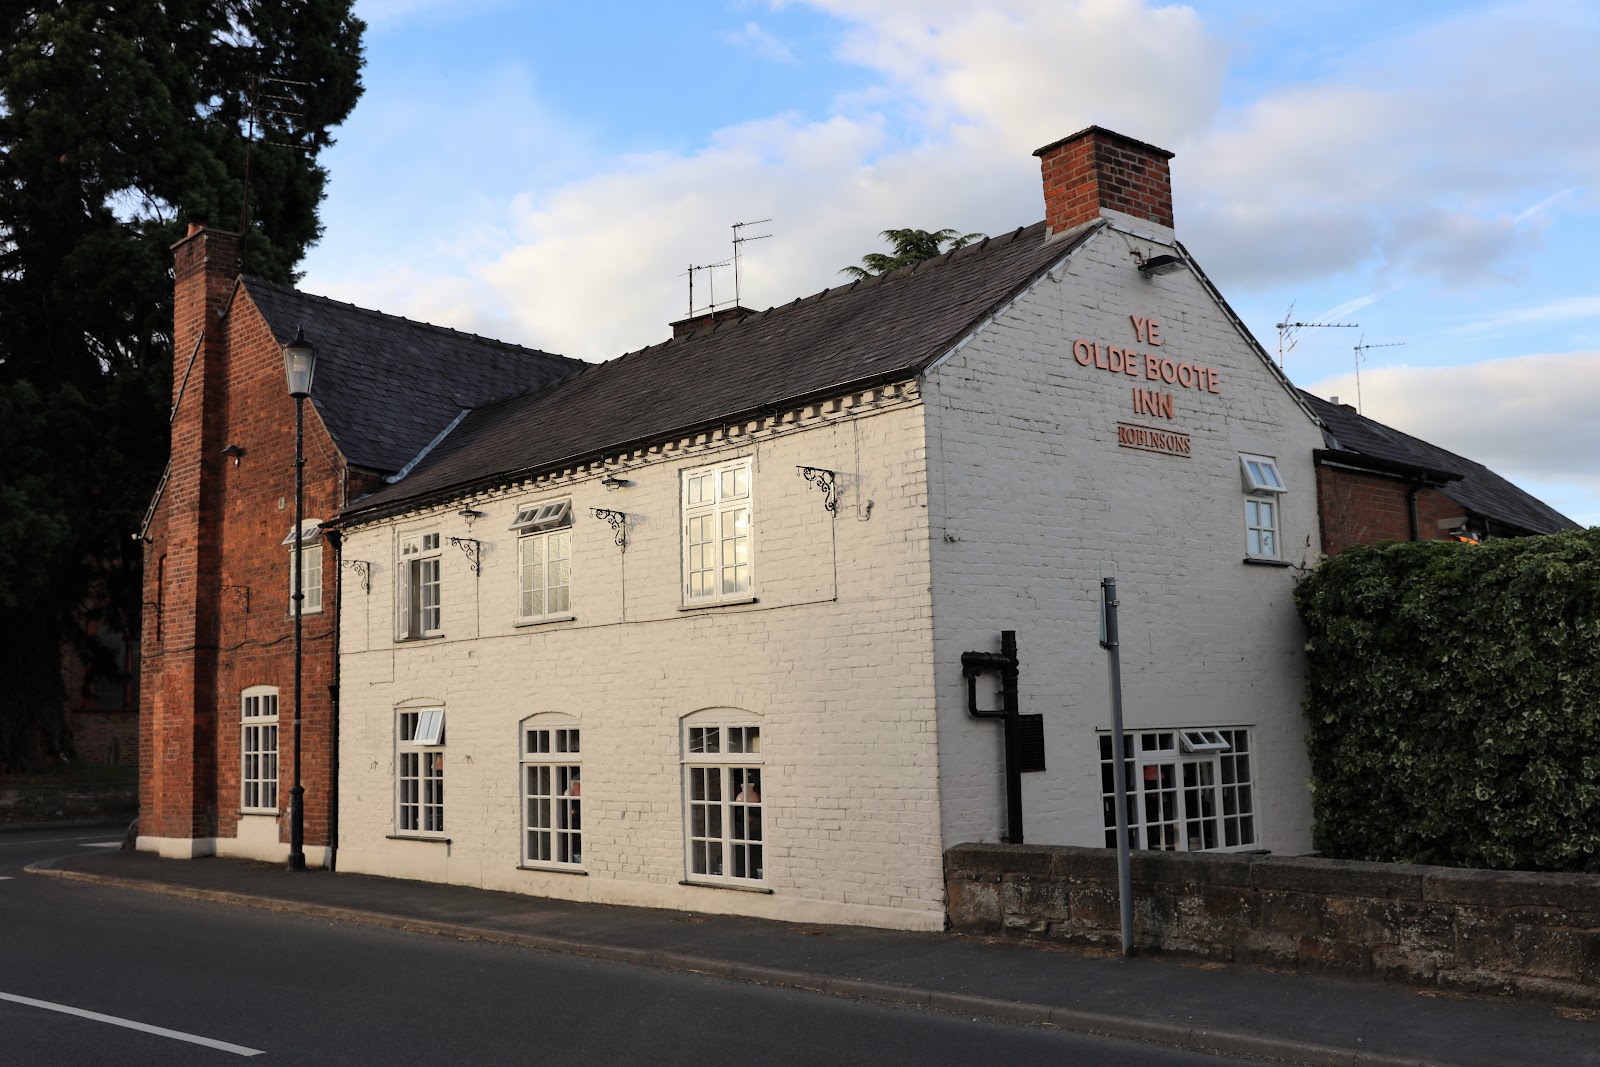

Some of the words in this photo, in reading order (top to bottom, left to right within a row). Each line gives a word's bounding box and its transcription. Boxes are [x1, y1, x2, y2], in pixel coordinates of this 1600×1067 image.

[1130, 315, 1162, 346] YE
[1073, 338, 1139, 376] OLDE
[1145, 353, 1221, 394] BOOTE
[1133, 387, 1174, 420] INN
[1118, 426, 1191, 453] ROBINSONS
